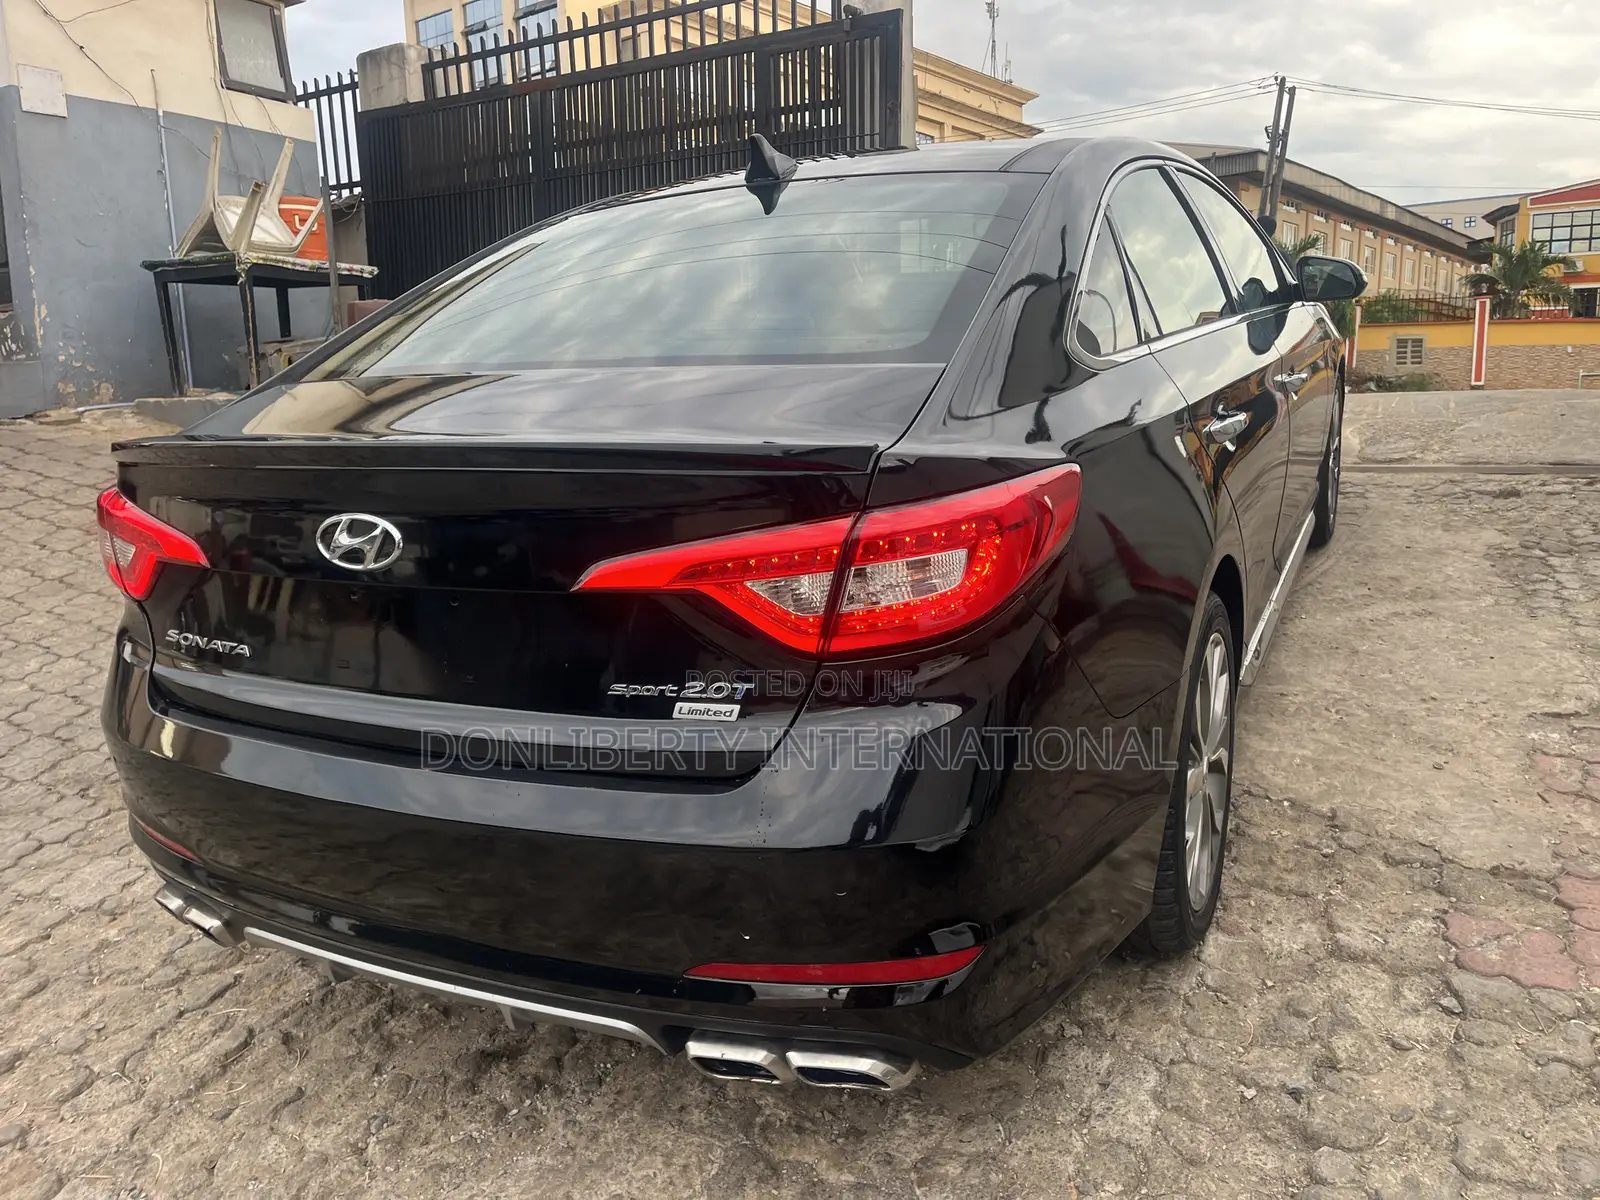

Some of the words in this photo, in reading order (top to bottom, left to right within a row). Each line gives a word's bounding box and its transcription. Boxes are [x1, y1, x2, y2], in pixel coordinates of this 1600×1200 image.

[165, 629, 251, 658] SONATA
[607, 683, 679, 698] Sport
[680, 681, 755, 700] 2.0T
[677, 706, 735, 718] Limited
